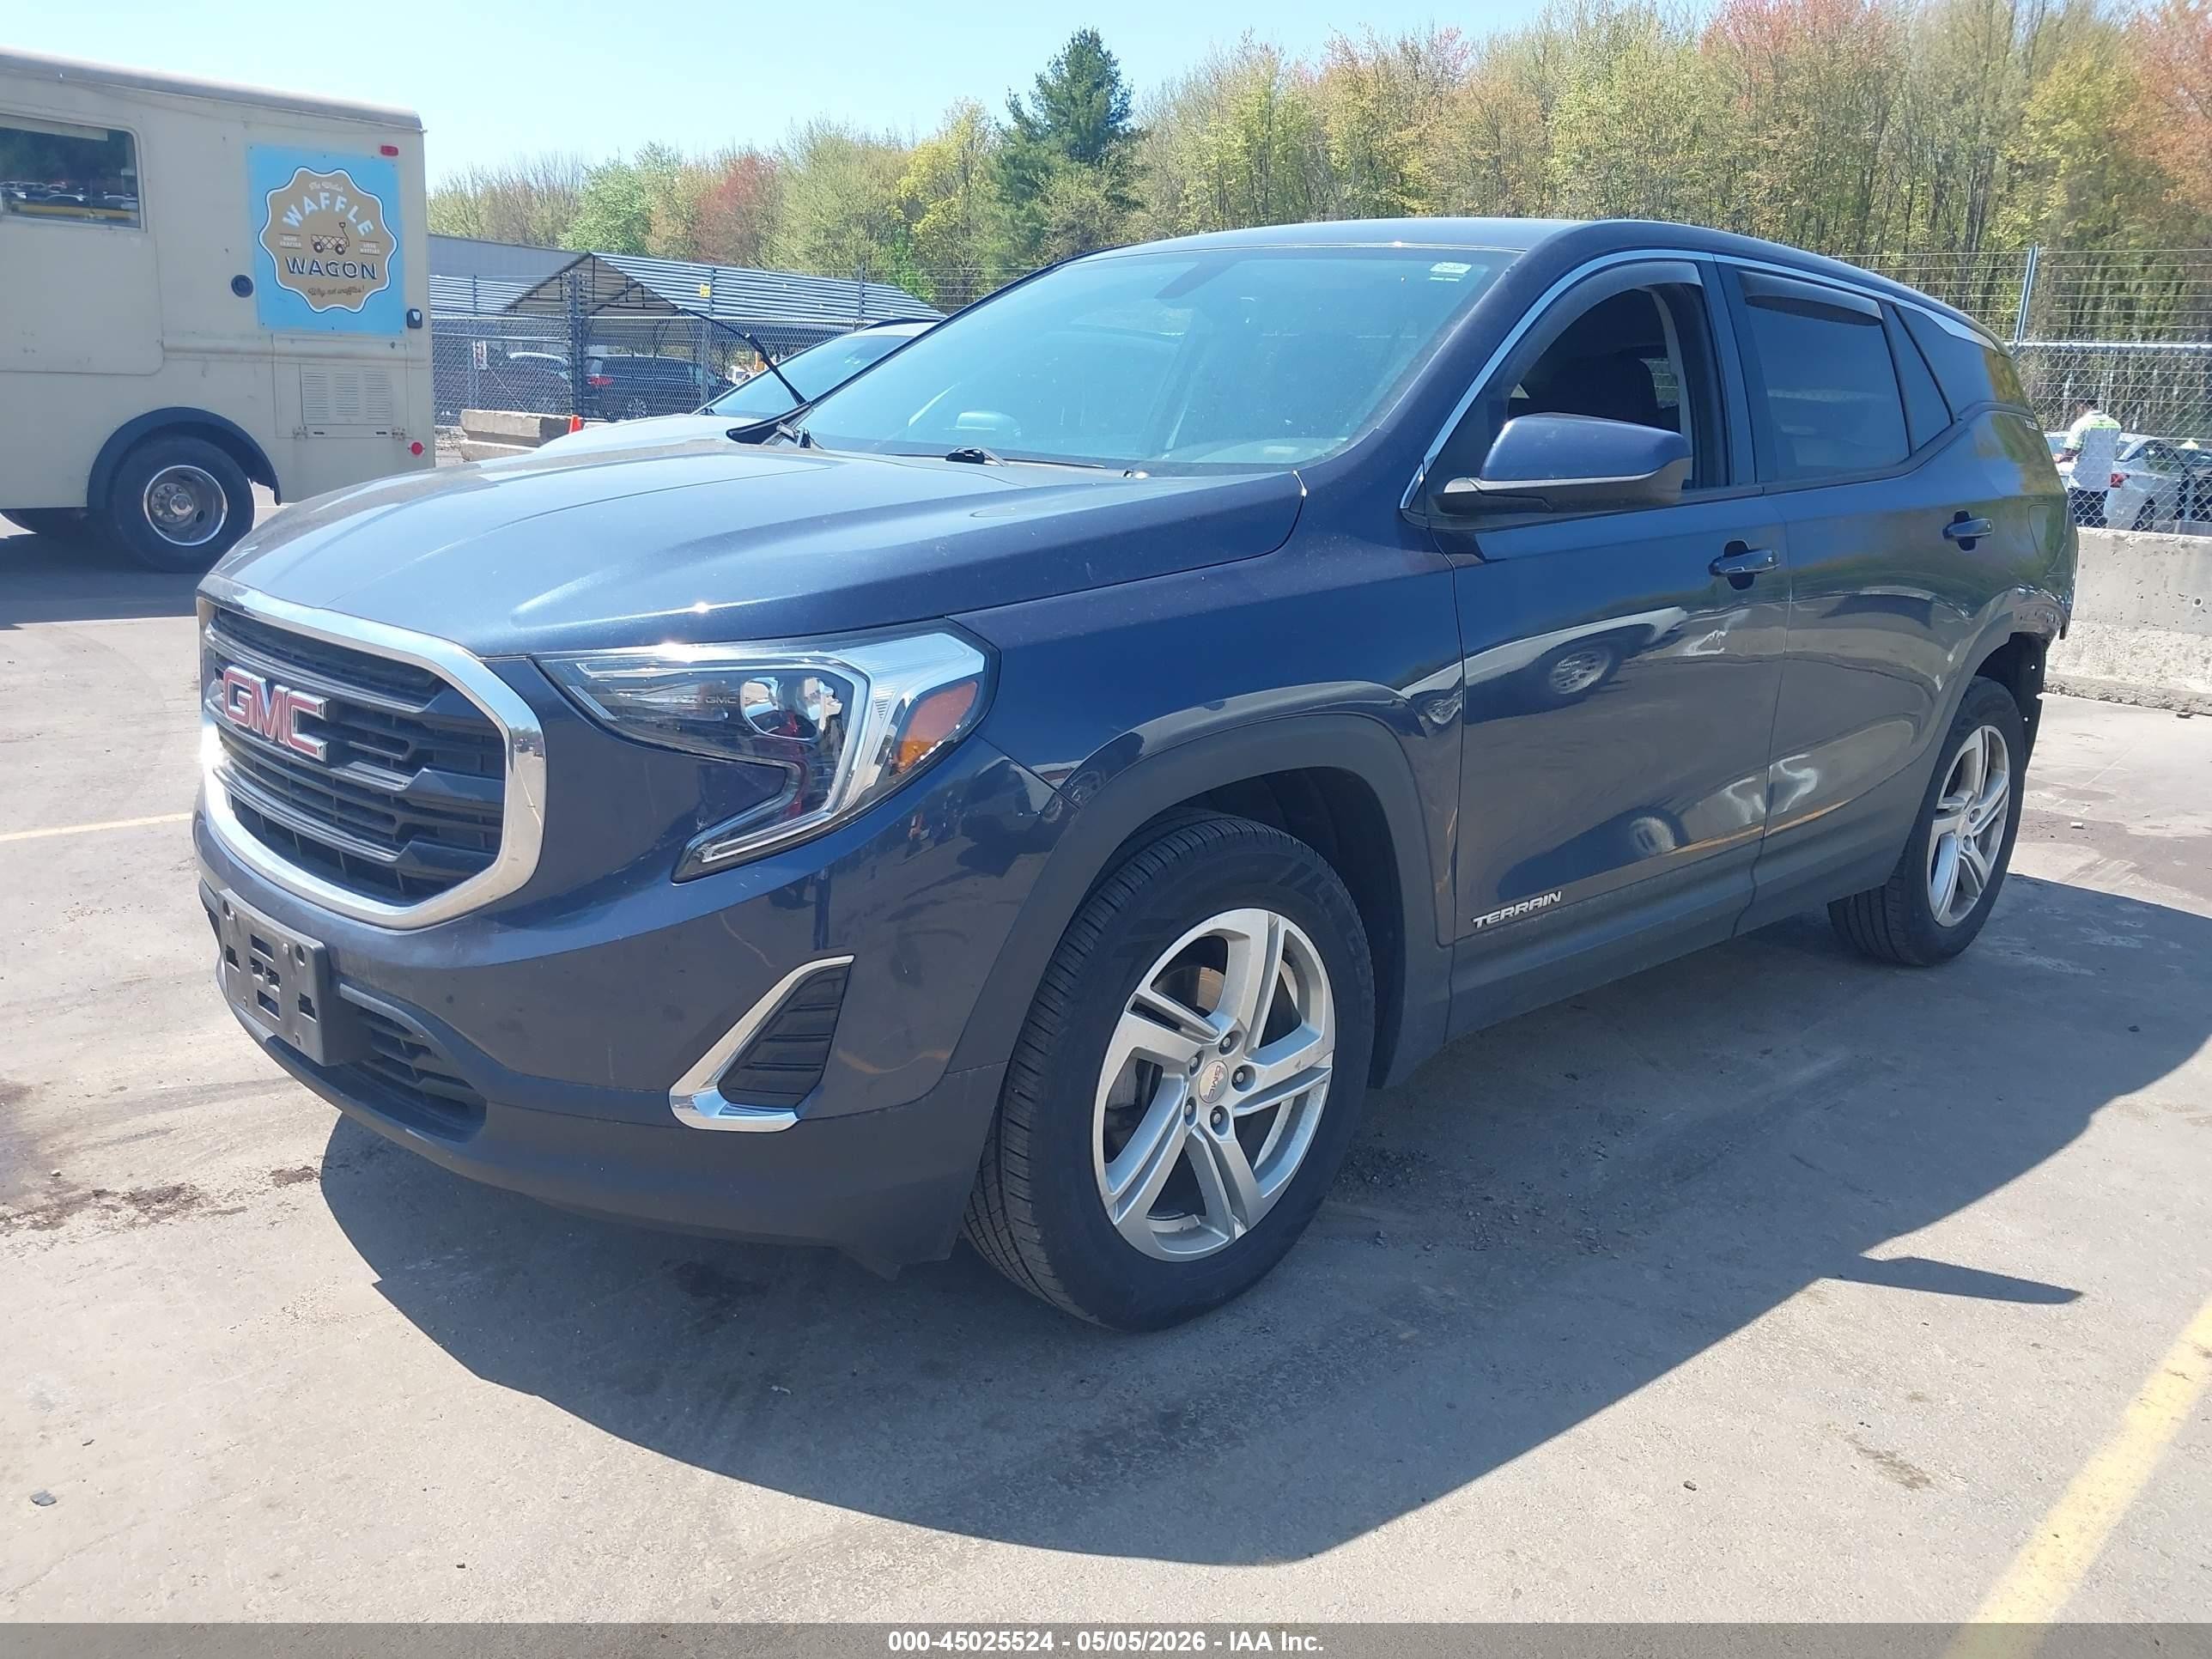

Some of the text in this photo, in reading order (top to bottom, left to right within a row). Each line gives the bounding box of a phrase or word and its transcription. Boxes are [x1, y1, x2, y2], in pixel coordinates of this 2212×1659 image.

[282, 191, 374, 236] WAFFLE
[285, 256, 378, 280] WAGON
[223, 665, 330, 763] GMC
[705, 696, 737, 704] GMC
[1472, 890, 1562, 929] TERRAIN
[1207, 1065, 1221, 1099] GMC
